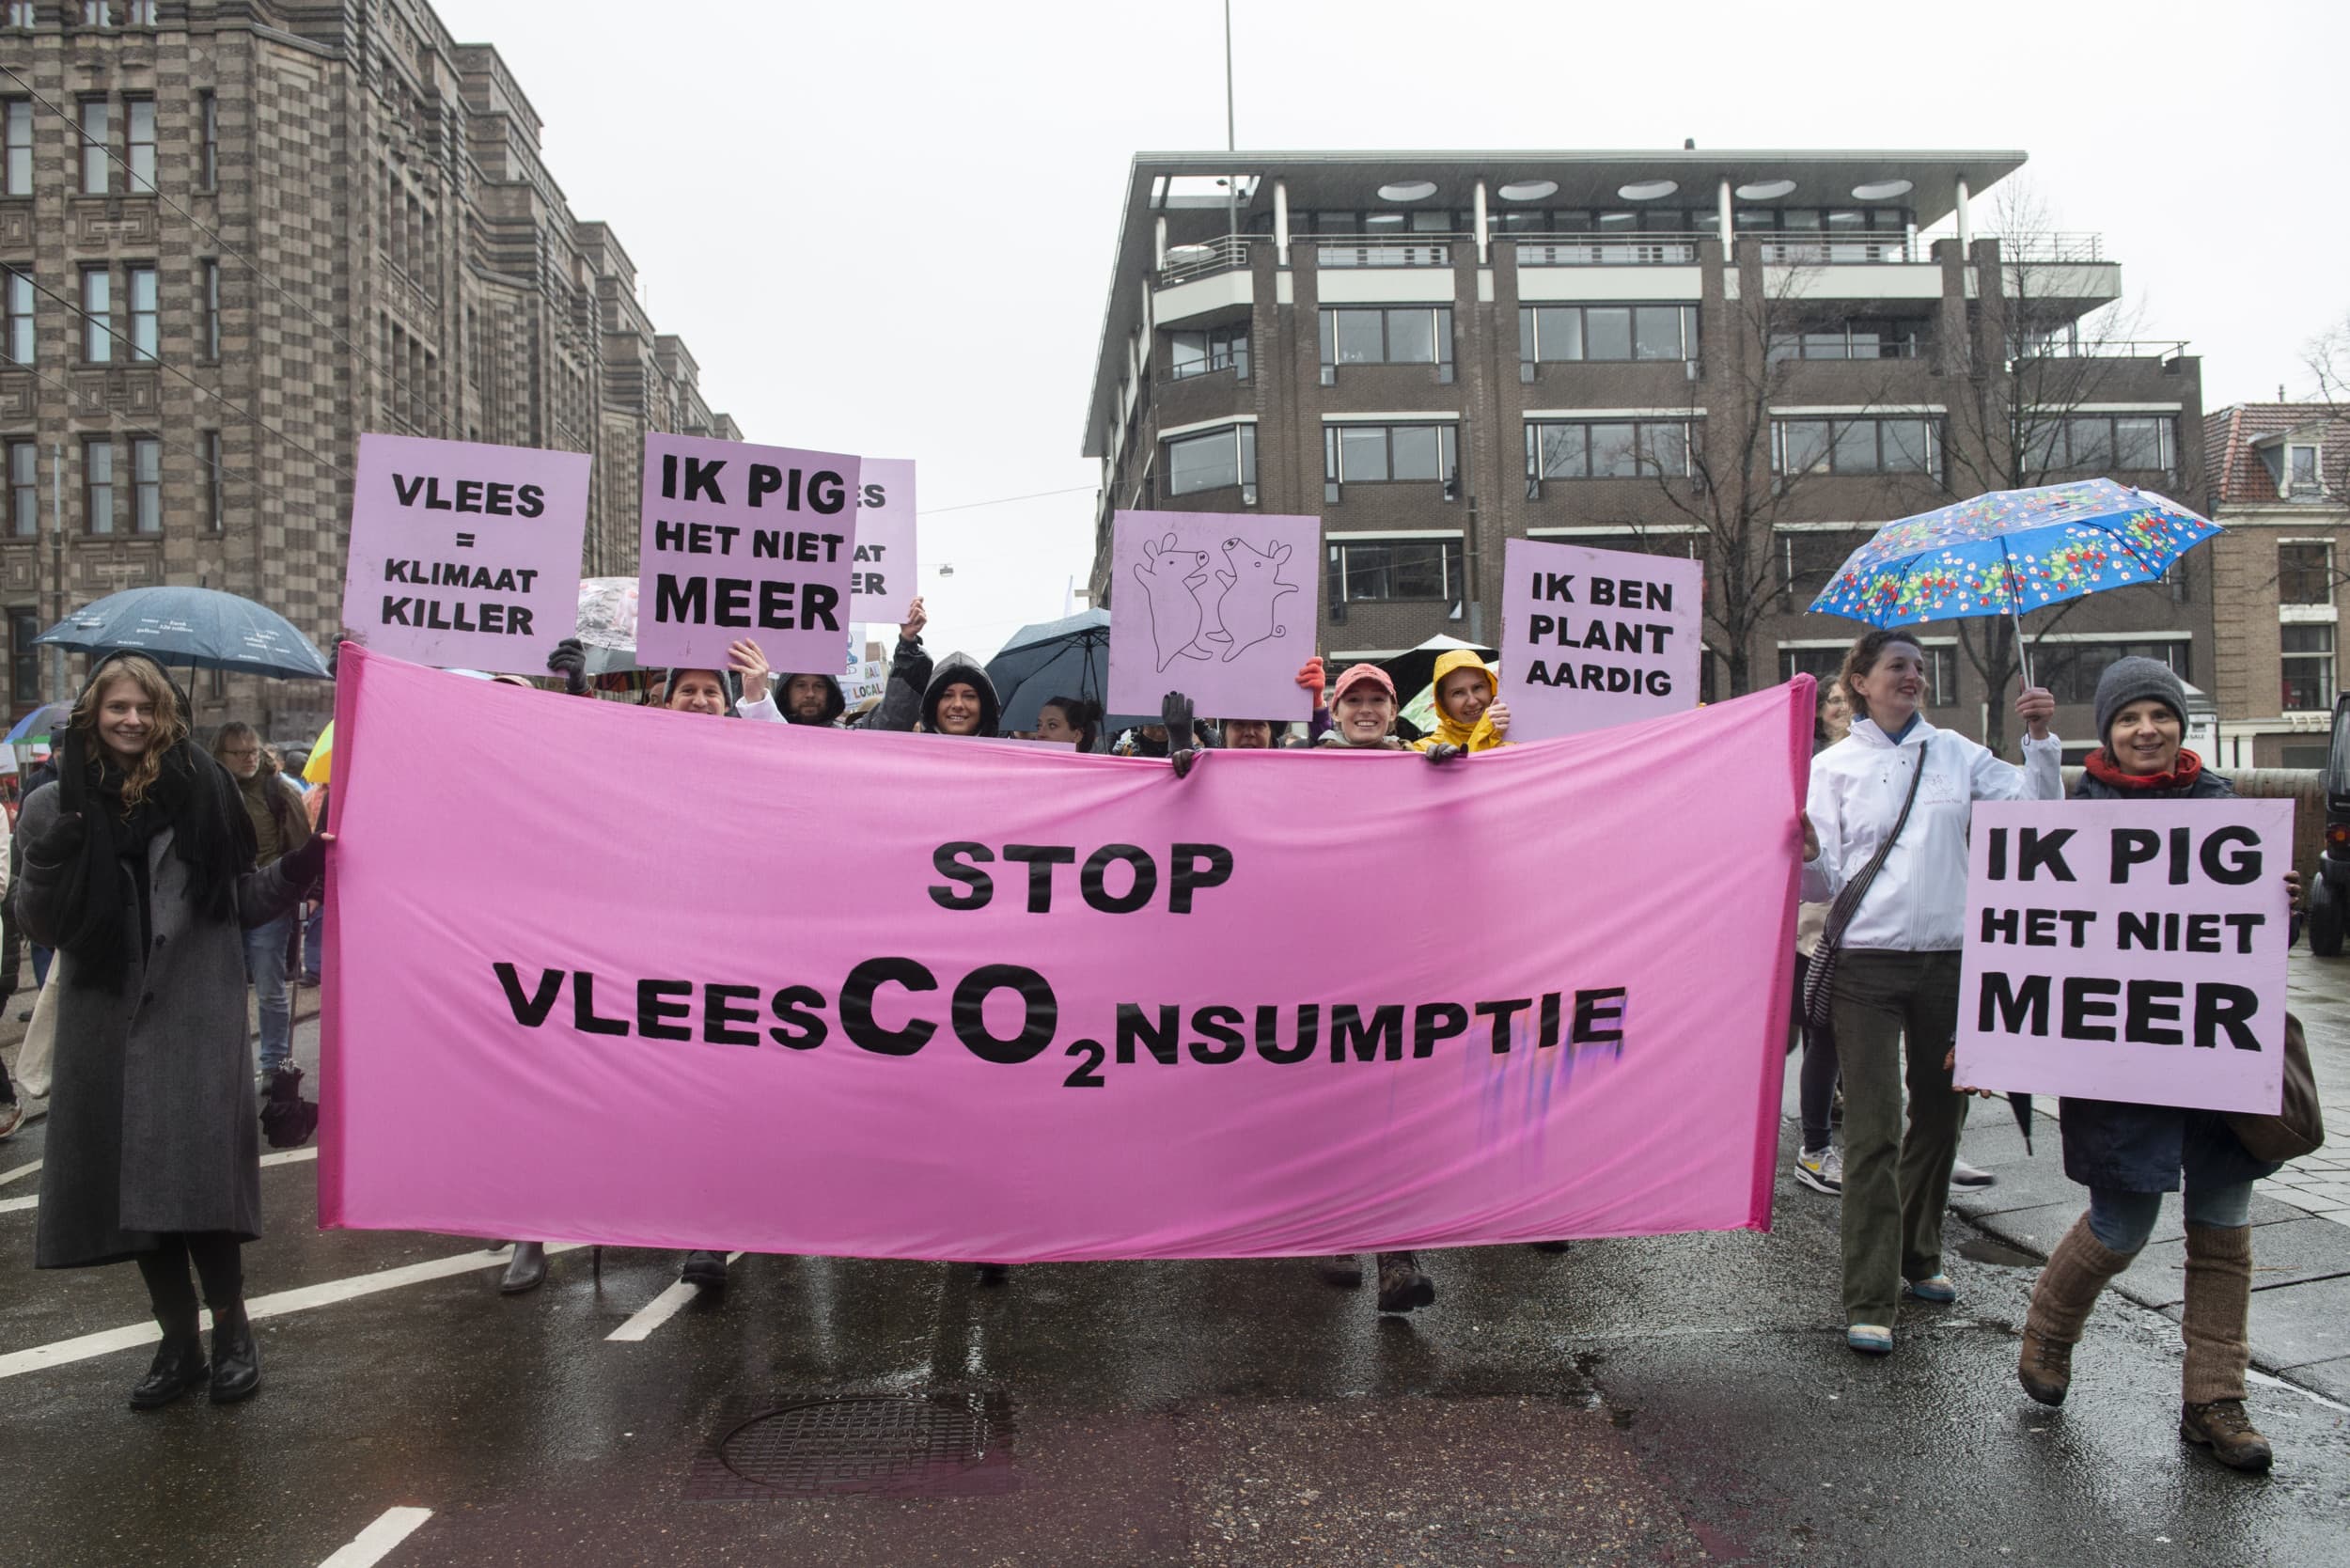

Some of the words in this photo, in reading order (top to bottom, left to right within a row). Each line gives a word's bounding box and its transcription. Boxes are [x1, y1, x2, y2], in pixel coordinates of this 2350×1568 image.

[392, 473, 544, 518] VLEES
[661, 454, 728, 505] IK
[747, 463, 846, 515] PIG
[655, 520, 741, 556] HET
[752, 529, 844, 563] NIET
[384, 558, 539, 593] KLIMAAT
[1532, 572, 1575, 604] IK
[1590, 576, 1672, 612] BEN
[382, 595, 534, 635] KILLER
[655, 573, 840, 632] MEER
[1529, 614, 1674, 655] PLANT
[853, 682, 884, 699] LOCAL
[1526, 660, 1671, 697] AARDIG
[1987, 827, 2077, 882] IK
[2109, 825, 2263, 886] PIG
[928, 841, 1234, 915] STOP
[1981, 907, 2097, 949] HET
[2117, 911, 2265, 954] NIET
[1978, 971, 2262, 1052] MEER
